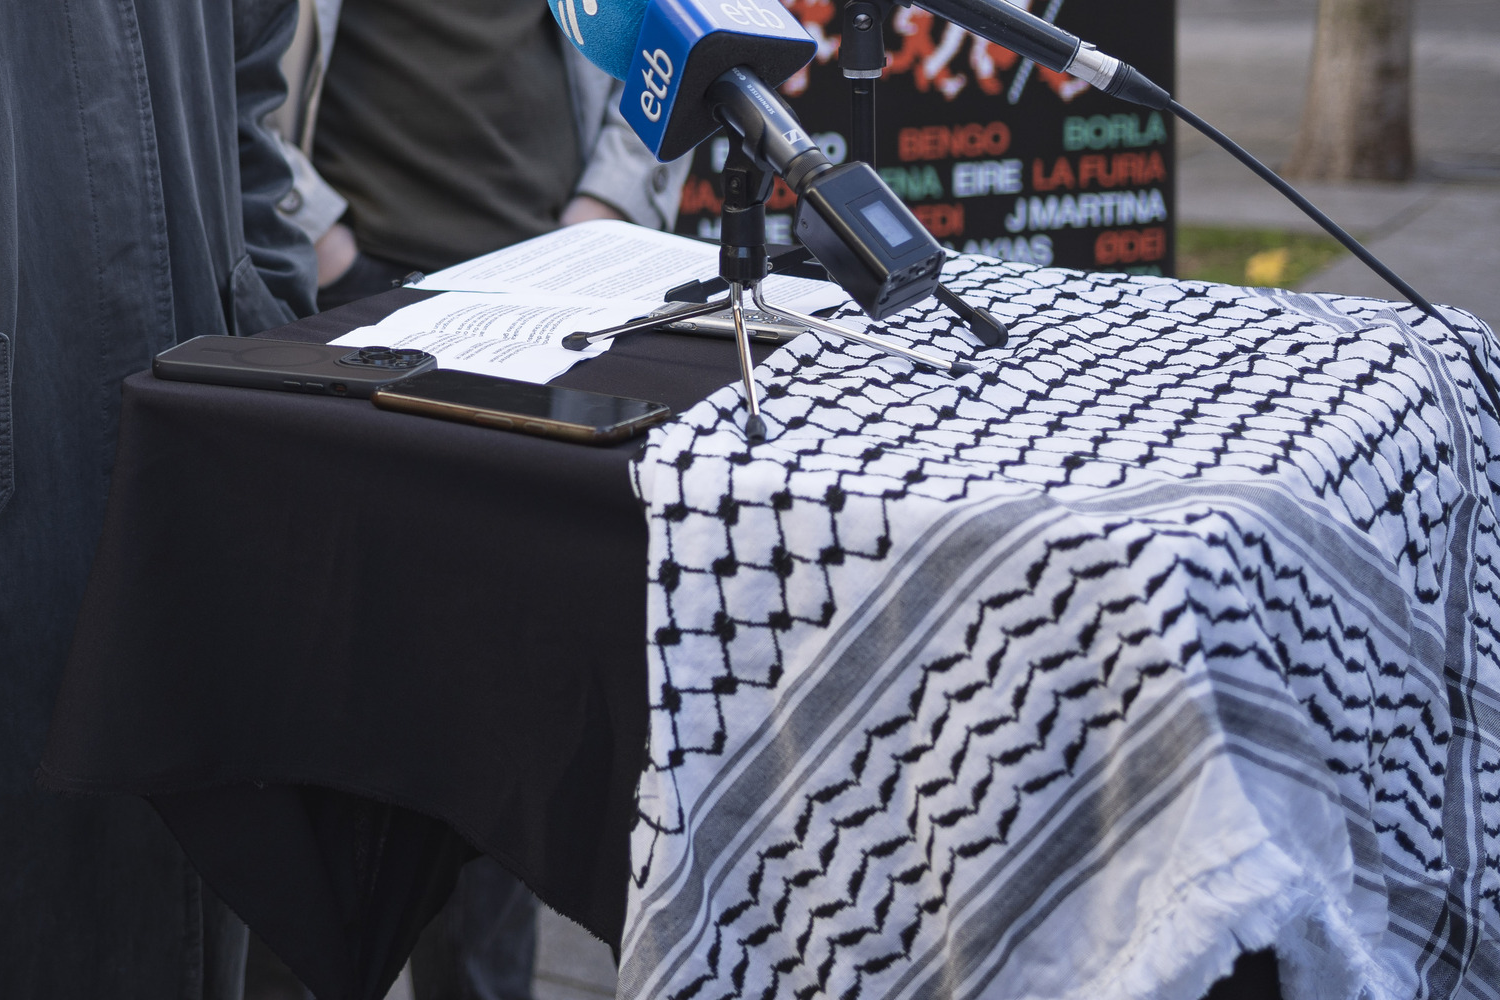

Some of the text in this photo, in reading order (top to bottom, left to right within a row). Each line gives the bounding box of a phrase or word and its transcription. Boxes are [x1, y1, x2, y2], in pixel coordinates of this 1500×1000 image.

[640, 48, 674, 124] etb
[898, 111, 1167, 162] BENGO BORLA
[953, 158, 1024, 198] EIRE
[1032, 156, 1076, 191] LA
[1078, 151, 1167, 188] FURIA
